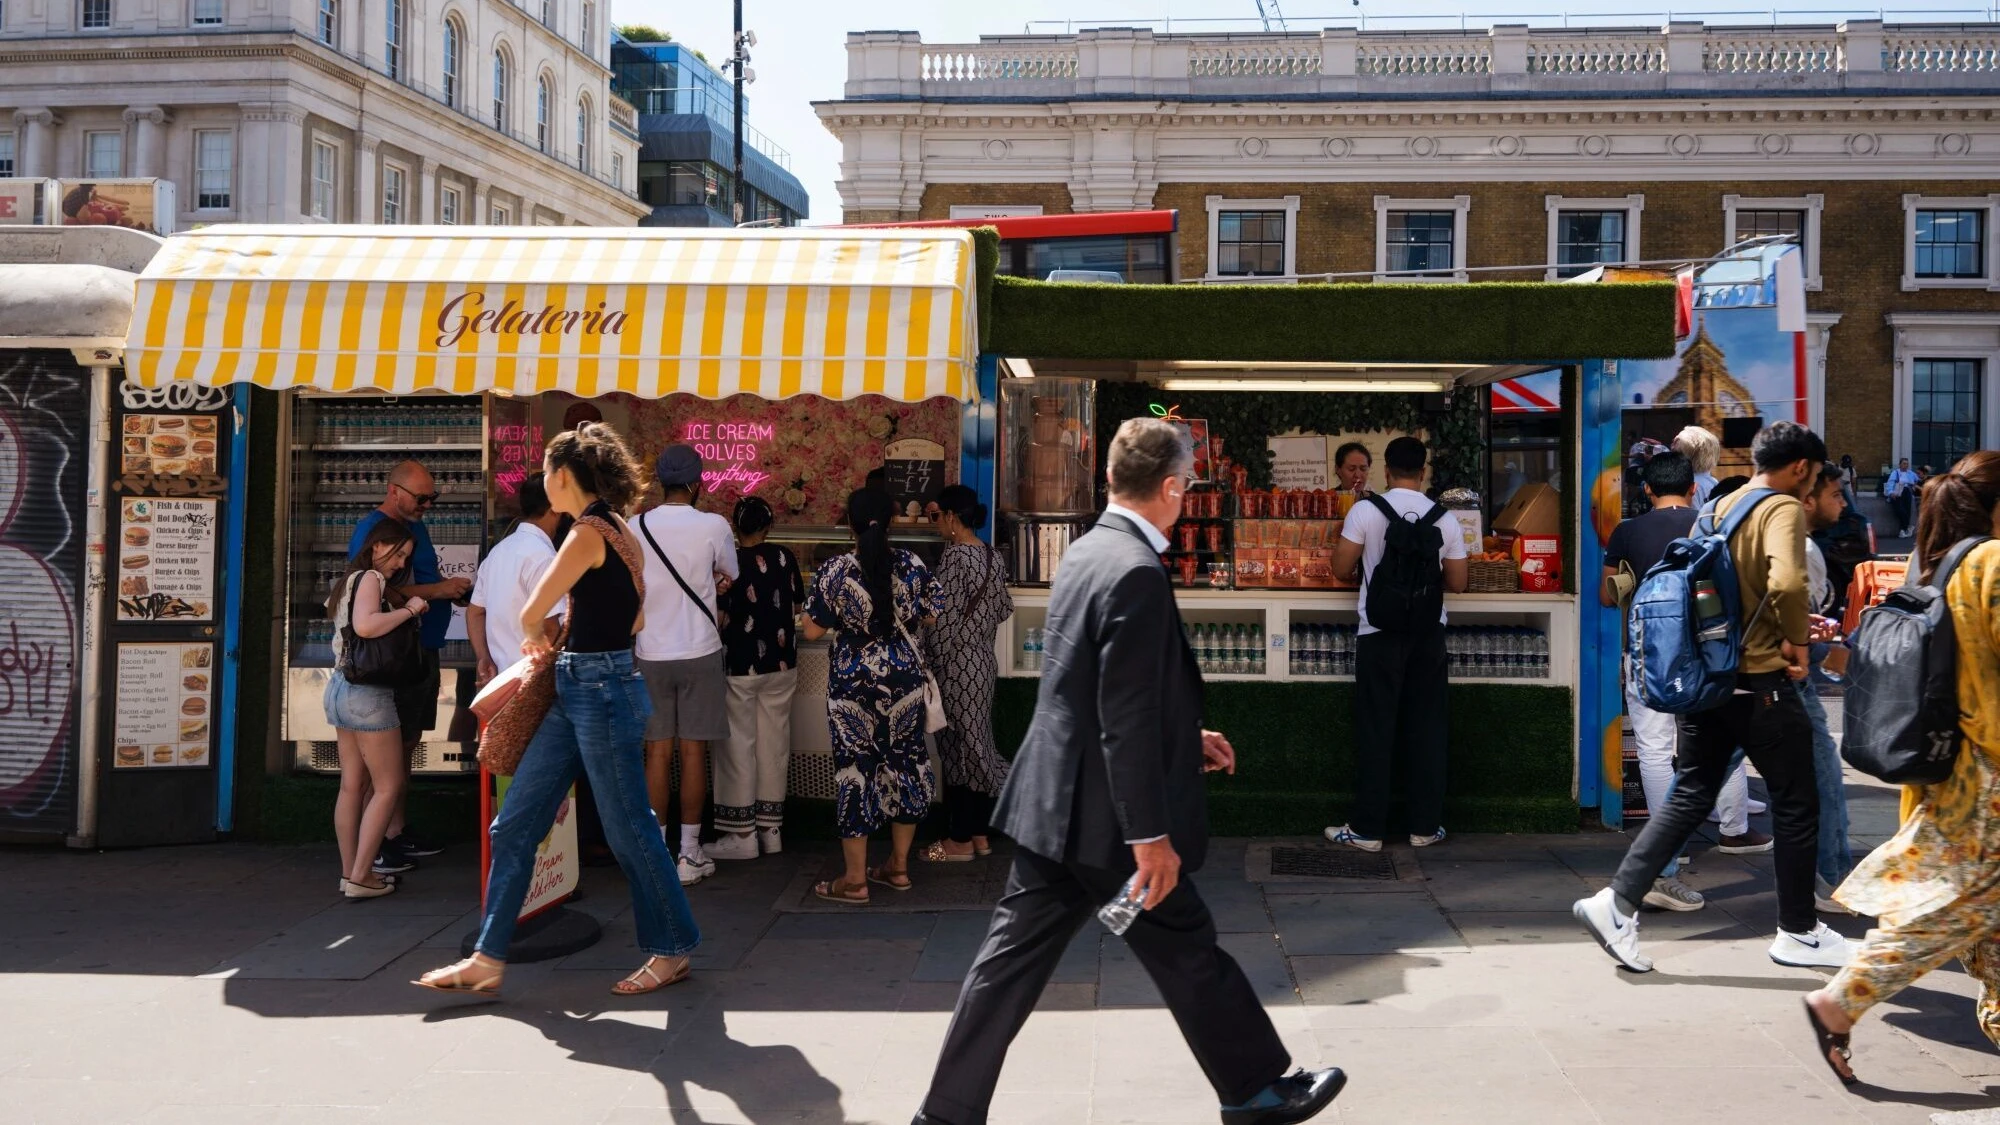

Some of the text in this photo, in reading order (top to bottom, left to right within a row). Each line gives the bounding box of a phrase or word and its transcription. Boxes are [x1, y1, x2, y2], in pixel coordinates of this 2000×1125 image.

[435, 291, 629, 347] Gelateria
[686, 424, 772, 440] ICE CREAM
[694, 443, 756, 460] SOLVES
[701, 462, 770, 493] erything
[1313, 475, 1325, 485] £8
[183, 502, 203, 510] Chips
[157, 514, 170, 522] Hot
[172, 514, 187, 523] Dog
[184, 568, 200, 576] Chips
[439, 563, 476, 574] ATERS
[120, 671, 163, 680] Sausage Roll
[117, 737, 137, 745] Chips
[535, 851, 564, 877] Cream
[543, 871, 564, 892] Here
